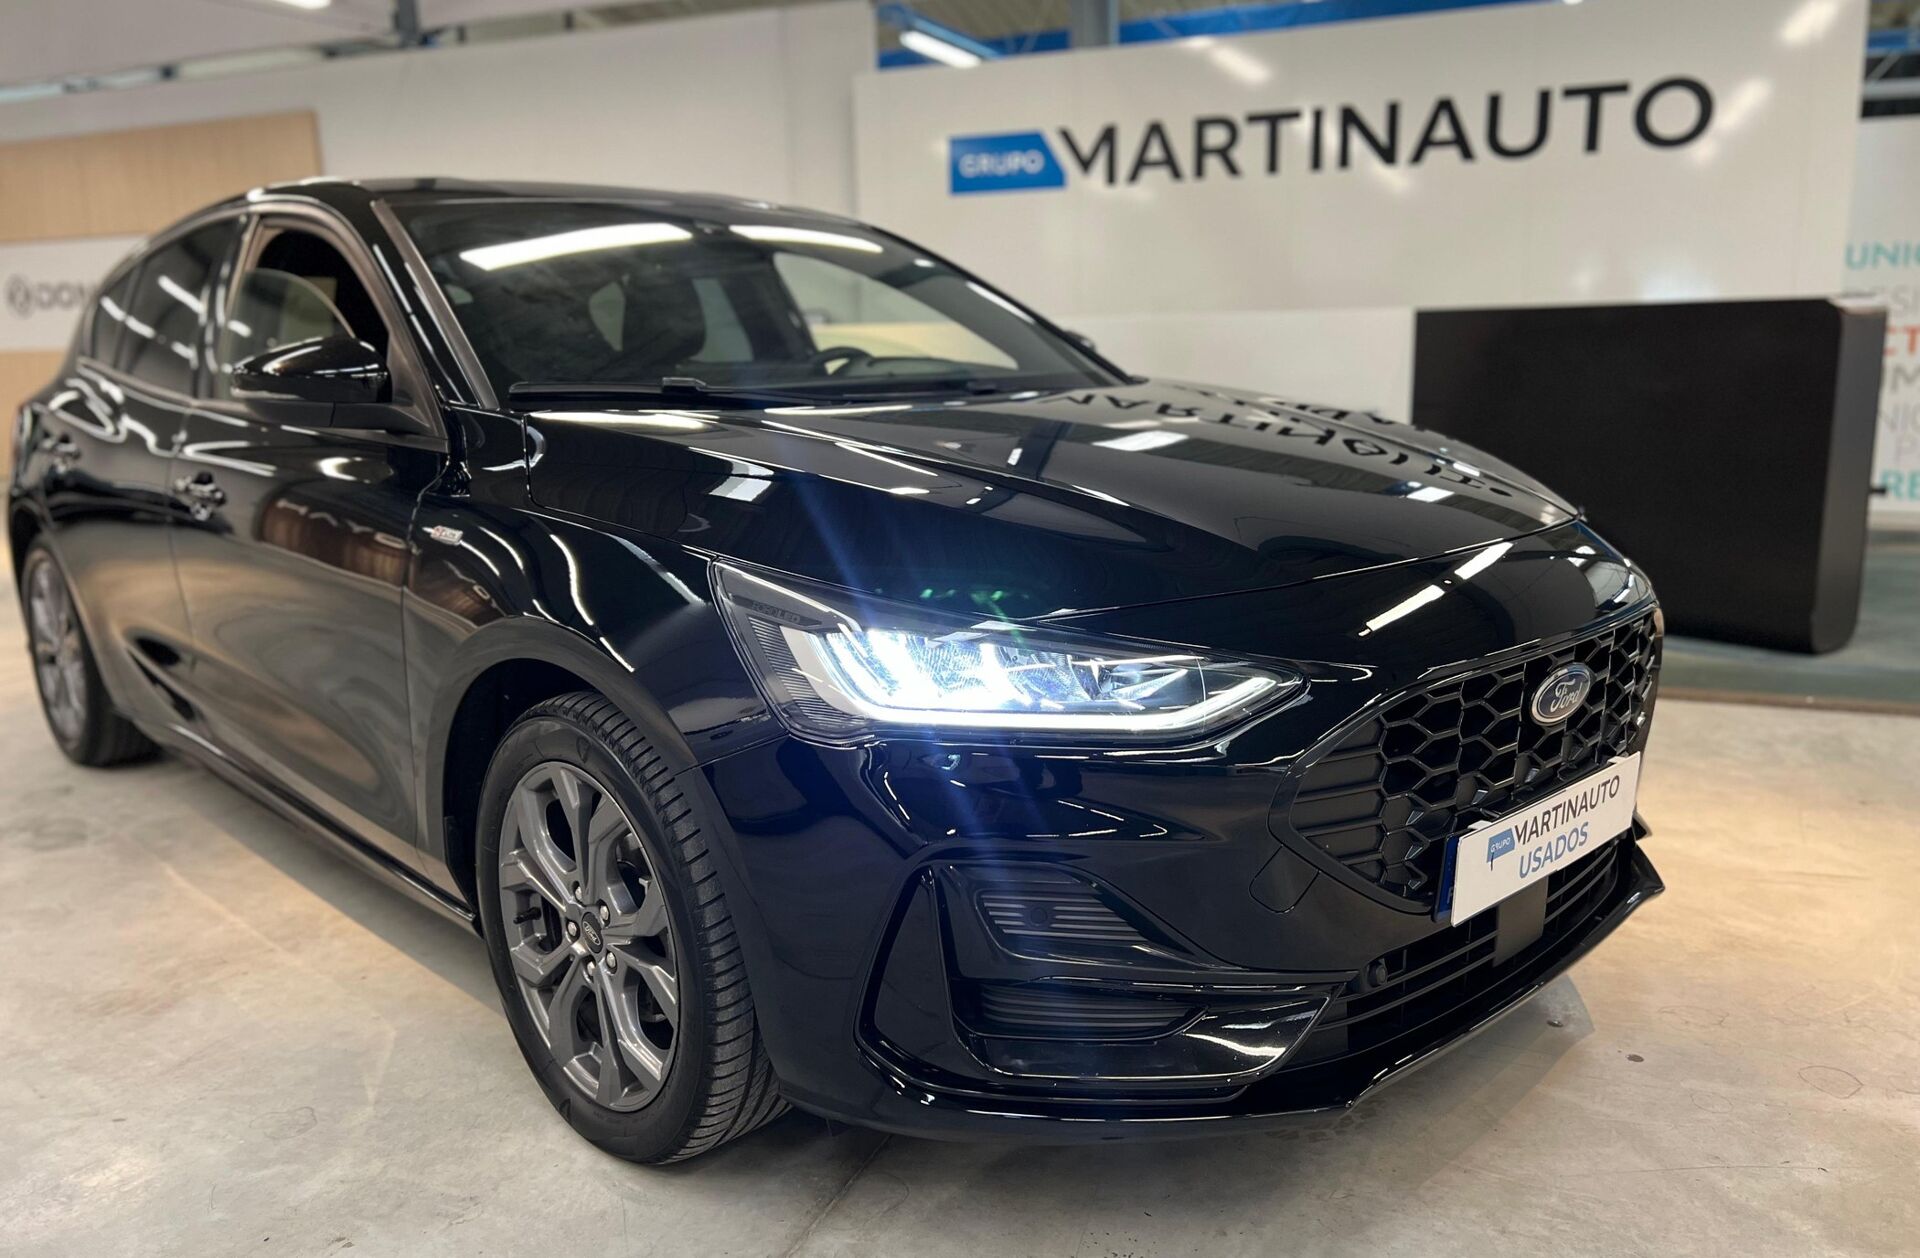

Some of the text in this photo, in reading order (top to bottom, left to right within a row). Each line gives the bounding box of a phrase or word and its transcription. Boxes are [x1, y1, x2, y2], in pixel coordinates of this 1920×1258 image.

[959, 76, 1714, 186] GRUPO MARTINAUTO
[1490, 775, 1620, 853] GRUPO MARTINAUTO
[1519, 821, 1589, 878] USADOS
